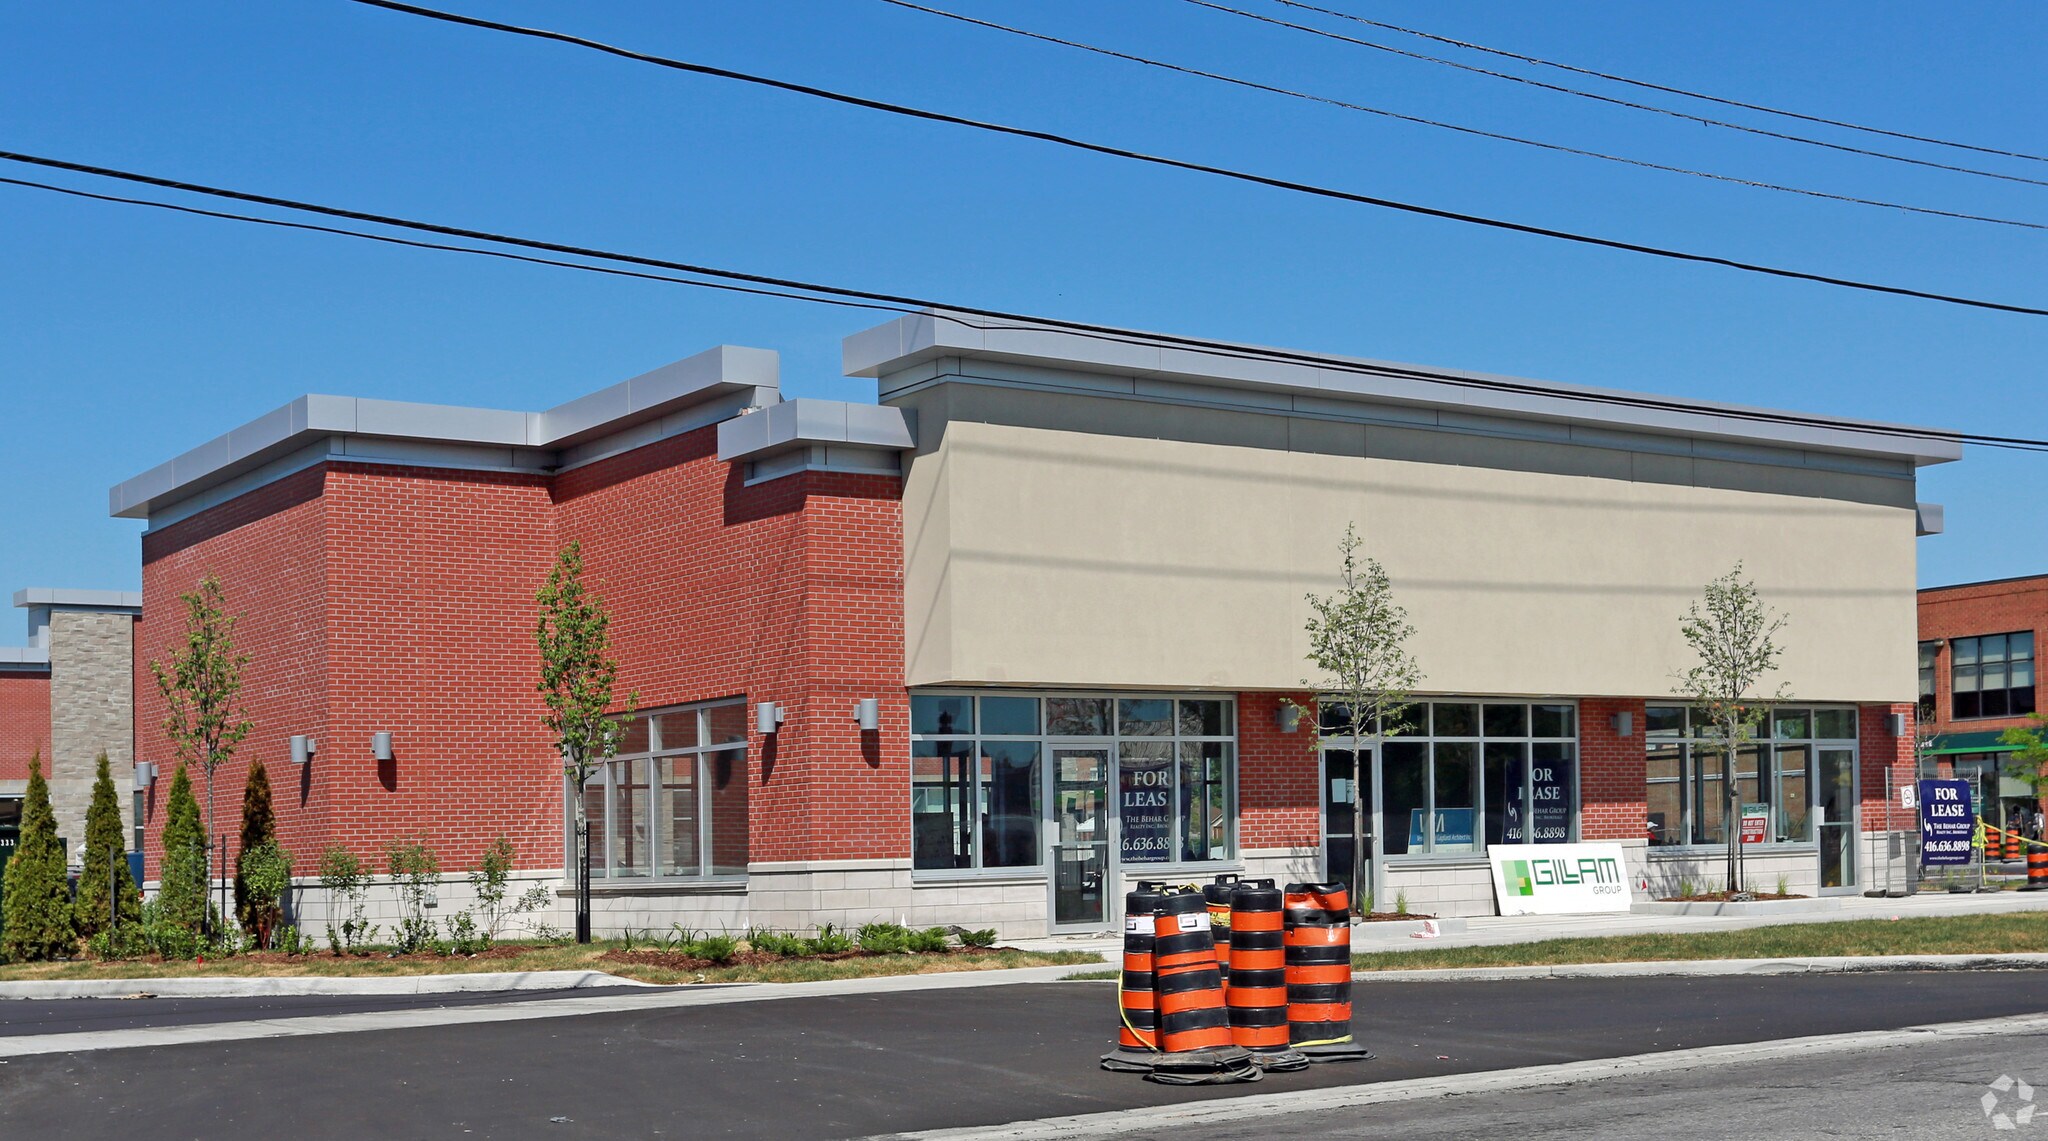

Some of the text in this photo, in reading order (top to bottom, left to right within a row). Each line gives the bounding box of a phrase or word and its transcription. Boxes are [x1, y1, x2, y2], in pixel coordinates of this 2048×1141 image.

[1133, 771, 1169, 786] FOR
[1533, 768, 1553, 781] OR
[1124, 791, 1168, 807] LEAS
[1518, 787, 1560, 800] LASE
[1935, 788, 1958, 800] FOR
[1931, 804, 1965, 816] LEASE
[1126, 815, 1140, 823] THE
[1141, 815, 1162, 823] BEHAR
[1924, 841, 1970, 852] 416.636.8898
[1532, 858, 1620, 885] GILLAM
[1593, 886, 1622, 895] GROUP
